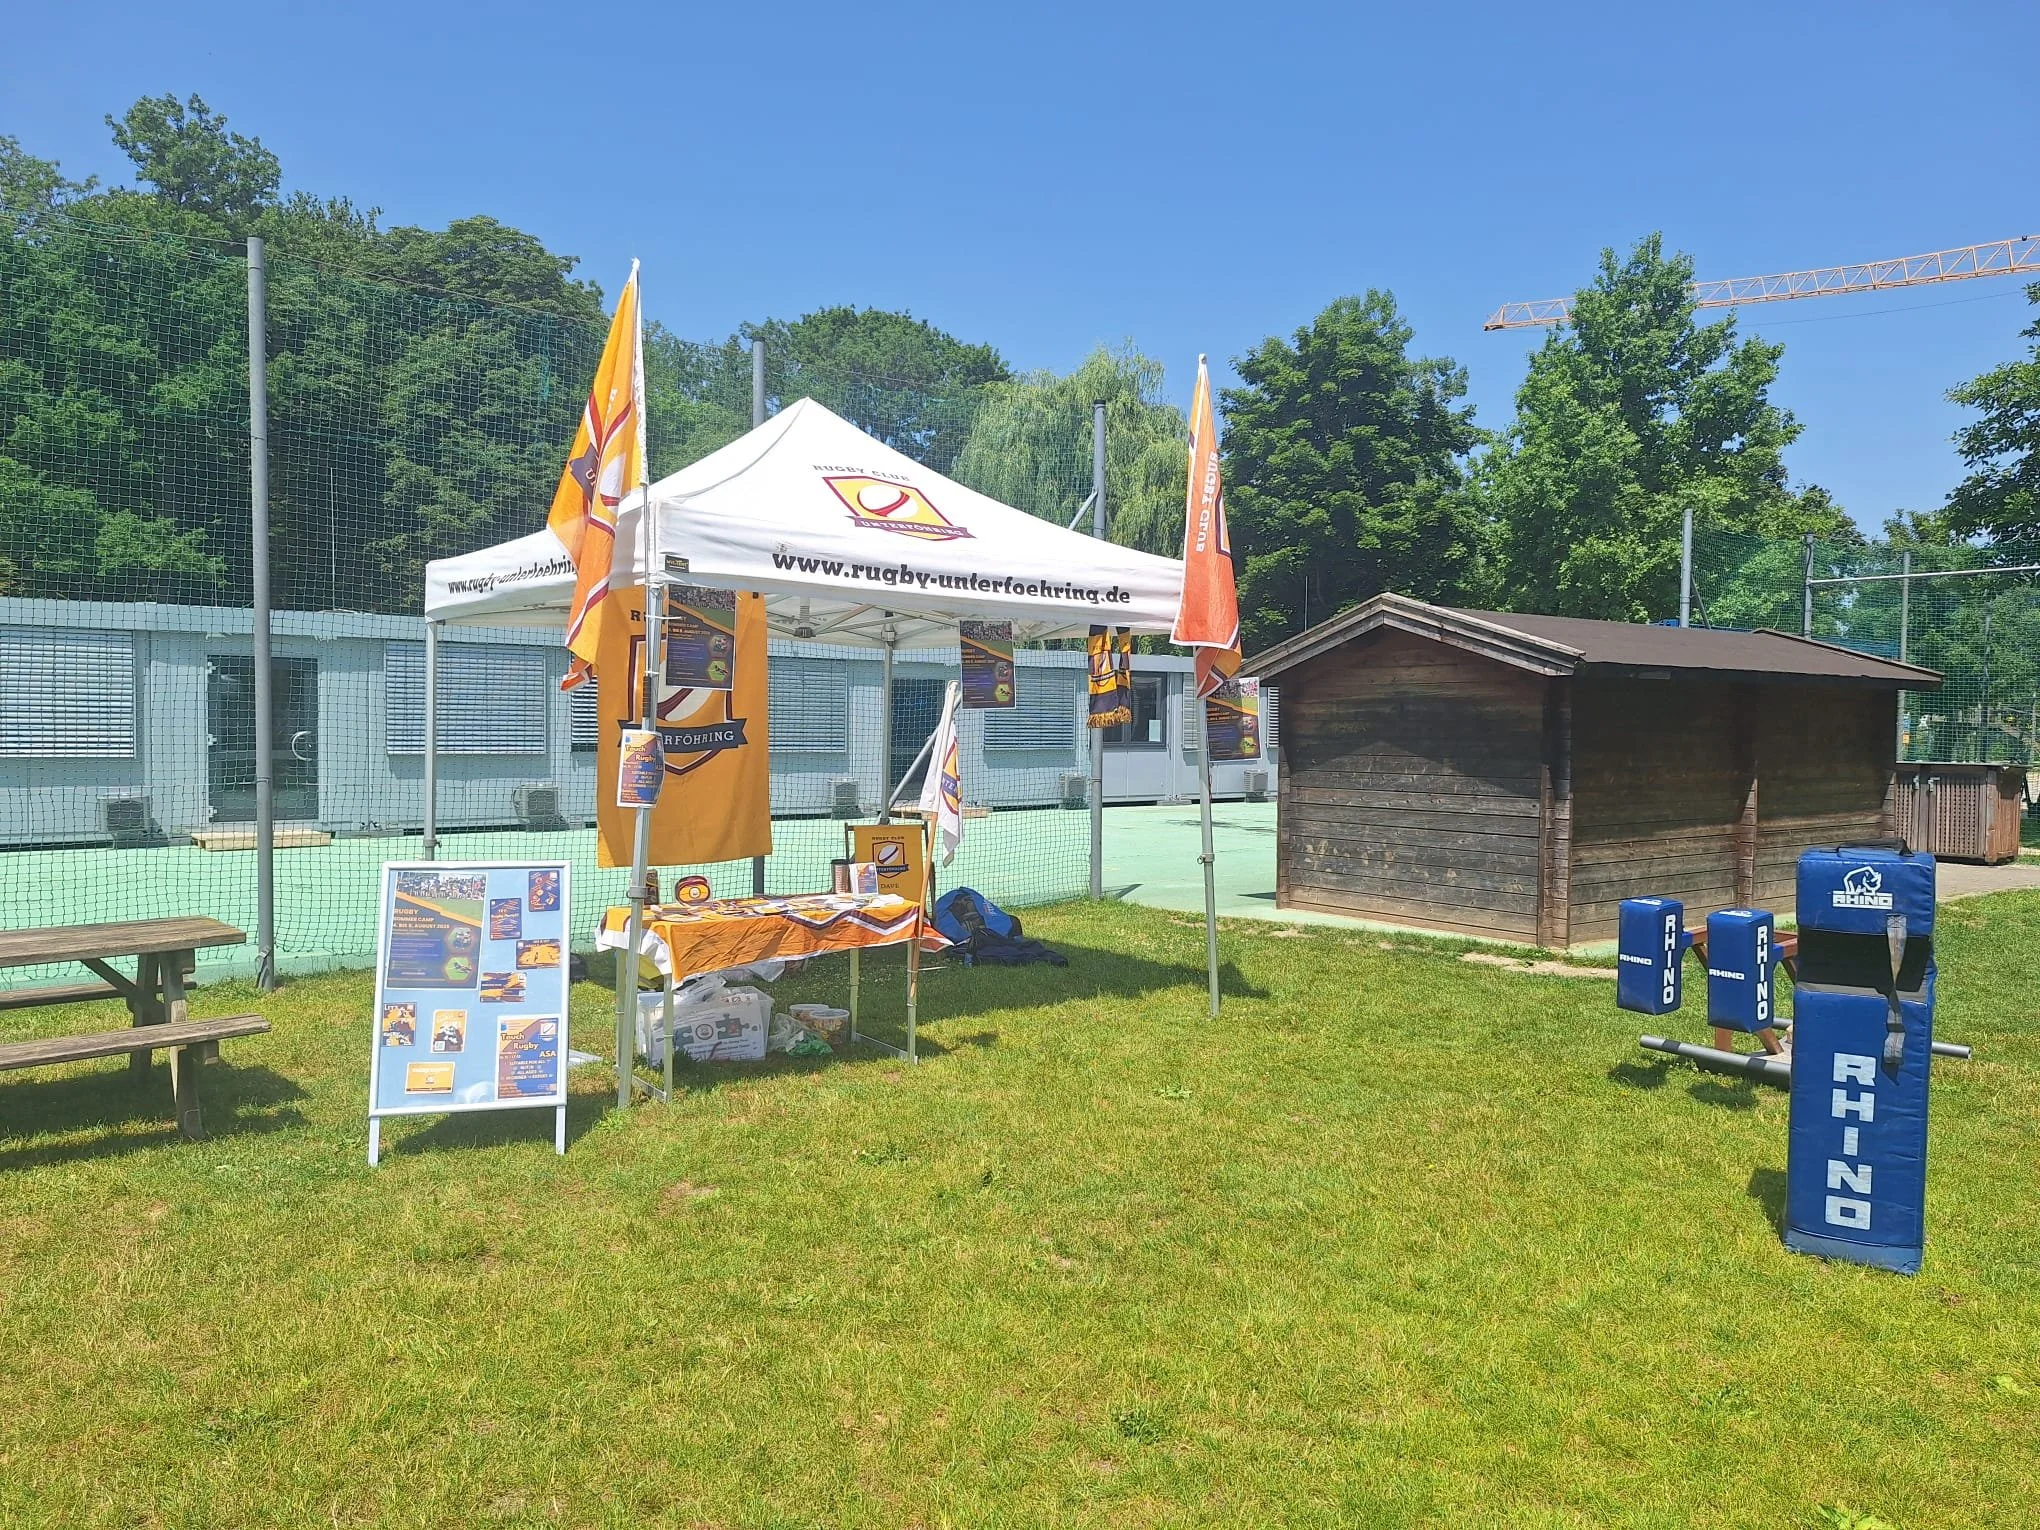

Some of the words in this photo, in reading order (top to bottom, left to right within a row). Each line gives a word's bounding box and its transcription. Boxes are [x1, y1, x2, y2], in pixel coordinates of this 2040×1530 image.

[812, 464, 865, 474] RUGBY
[871, 470, 910, 482] CLUB
[1202, 451, 1218, 504] RUGBY
[1196, 509, 1210, 552] CLUB
[447, 554, 577, 594] www.rugby-unterfoehrin
[772, 552, 1131, 605] www.rugby-unterfoehring.de
[663, 730, 735, 746] RFÖHRING
[1833, 893, 1893, 907] RHINO
[1619, 953, 1653, 966] RHINO
[1663, 914, 1676, 1005] RHINO
[1708, 968, 1745, 980] RHINO
[1757, 925, 1768, 1021] RHINO
[501, 1032, 525, 1040] Touch
[513, 1041, 539, 1051] Rugby
[539, 1050, 557, 1058] ASA
[1825, 1052, 1877, 1231] RHINO
